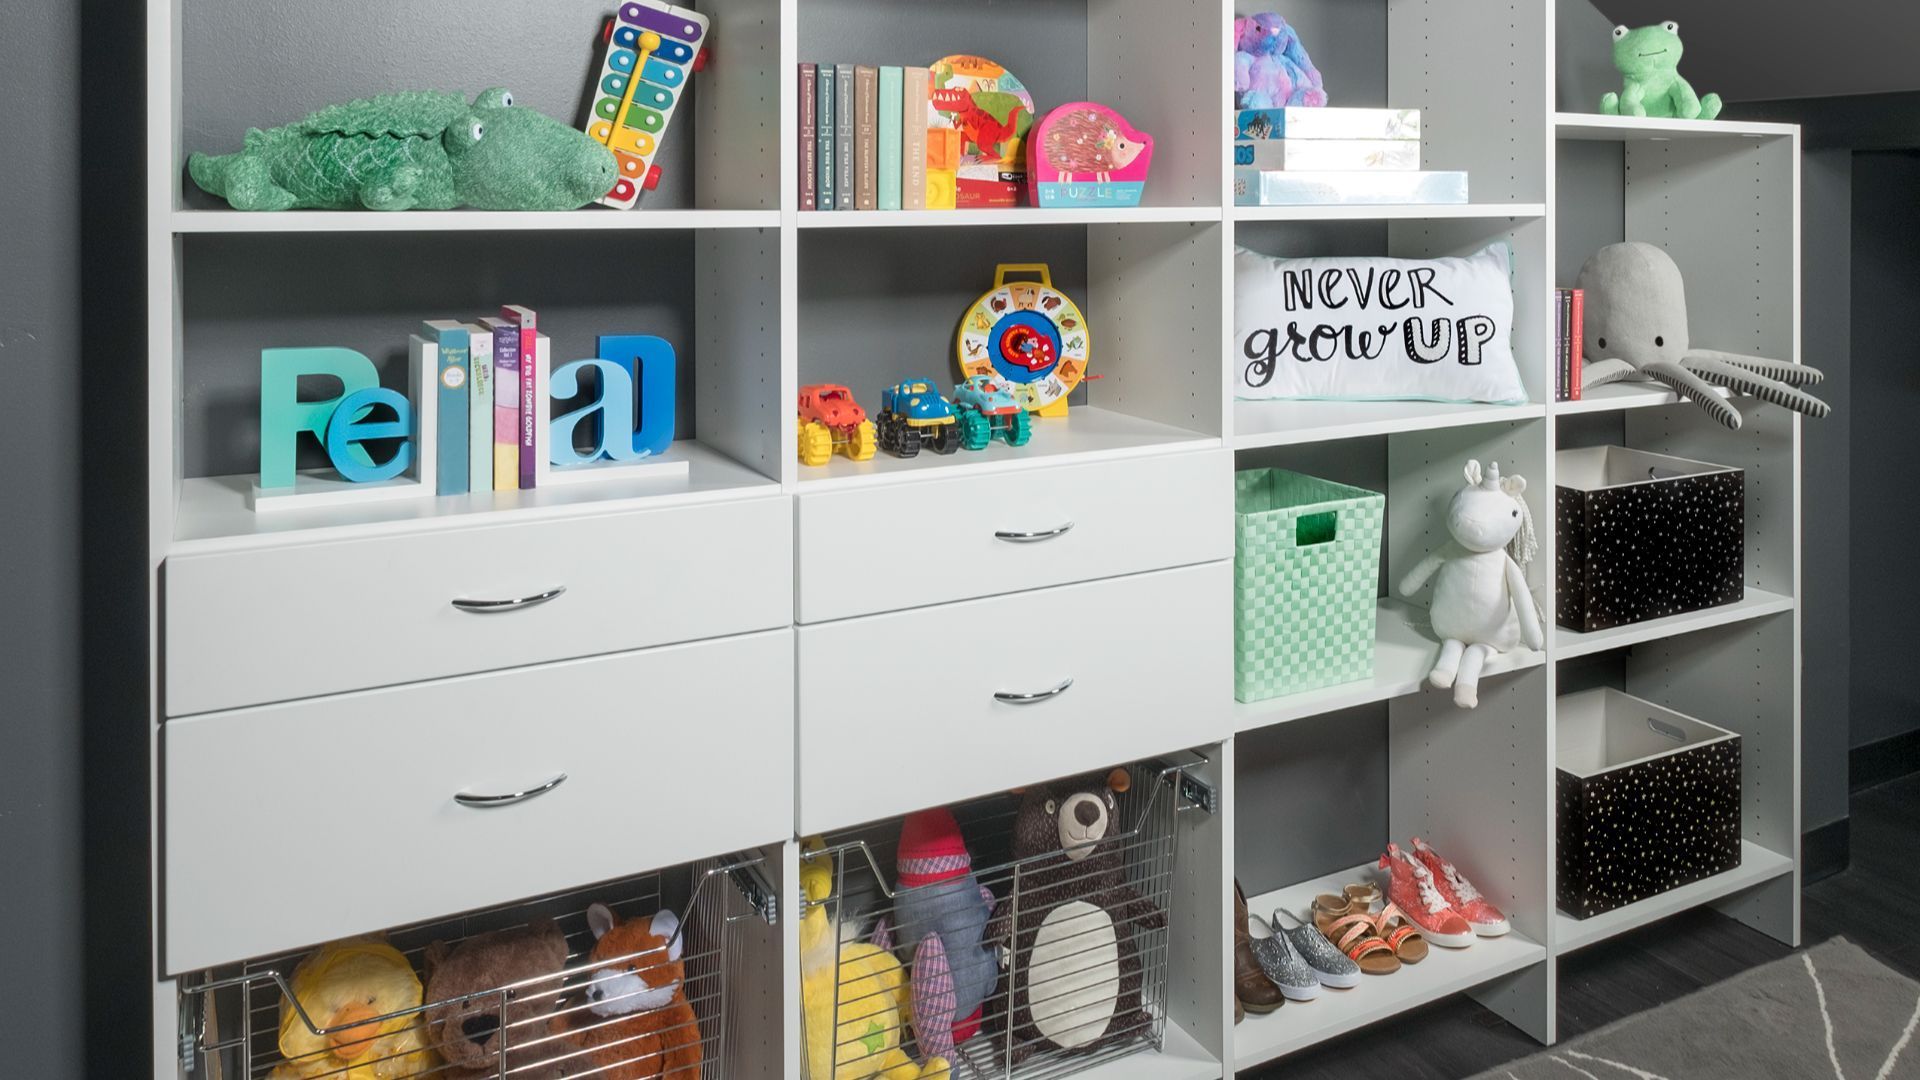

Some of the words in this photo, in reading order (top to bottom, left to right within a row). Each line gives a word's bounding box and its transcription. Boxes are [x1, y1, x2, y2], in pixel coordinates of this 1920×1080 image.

[1060, 187, 1112, 199] PUZZLE
[1243, 320, 1397, 388] grow
[1402, 314, 1496, 366] UP
